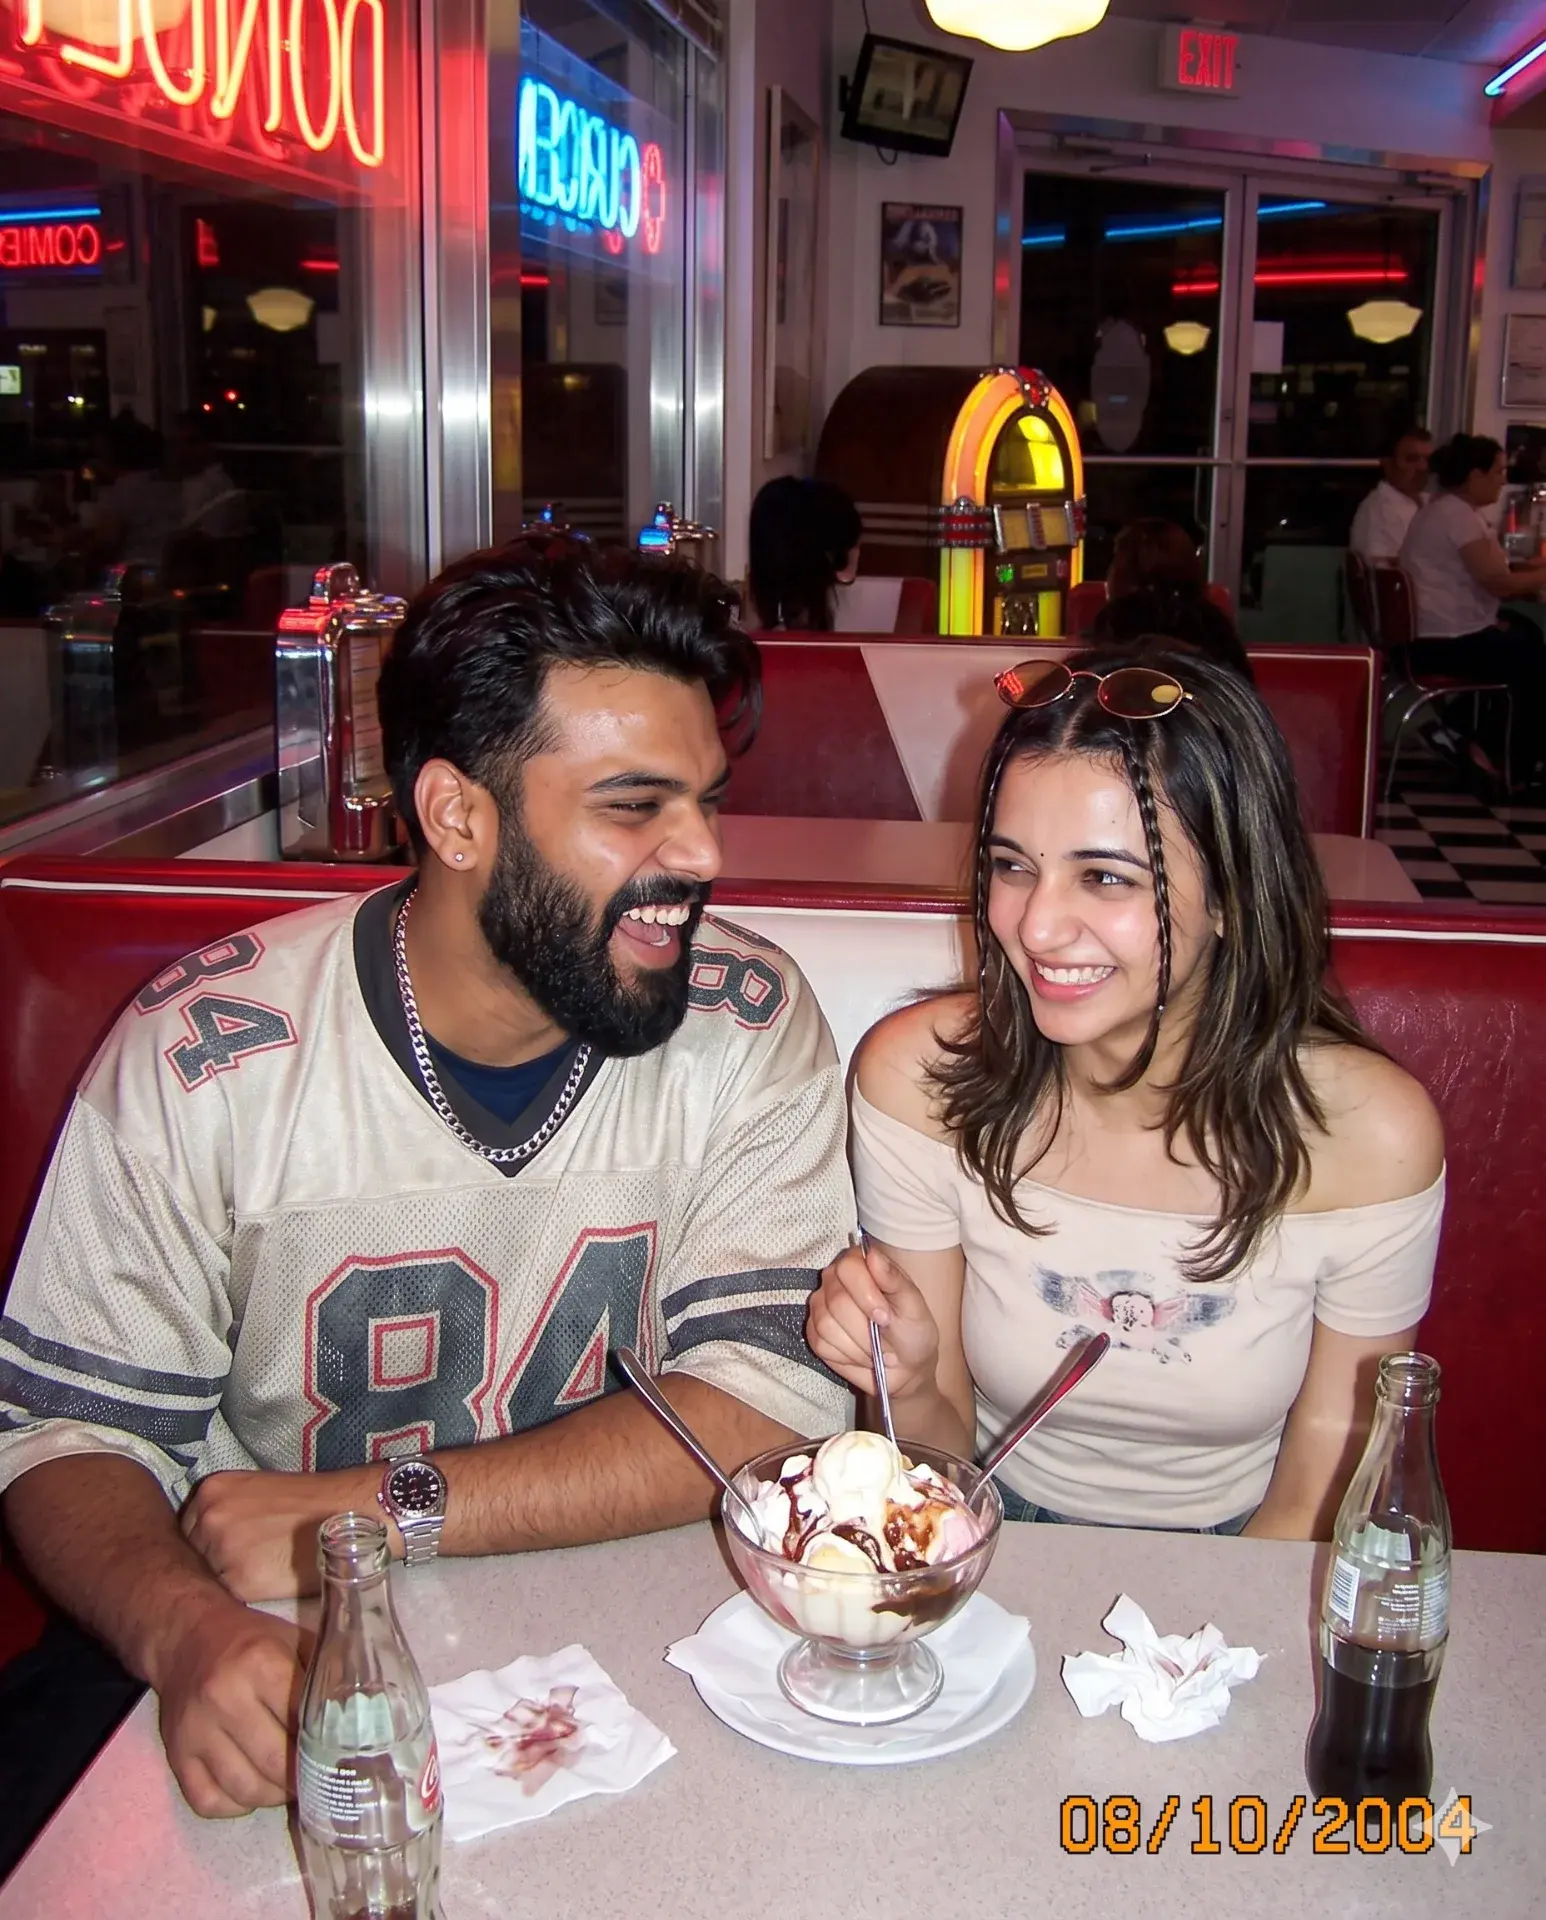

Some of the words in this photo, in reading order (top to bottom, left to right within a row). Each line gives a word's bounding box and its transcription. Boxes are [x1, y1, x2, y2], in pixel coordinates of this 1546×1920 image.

[1178, 29, 1239, 90] EXIT
[687, 911, 790, 1031] 8
[302, 1220, 655, 1473] 84
